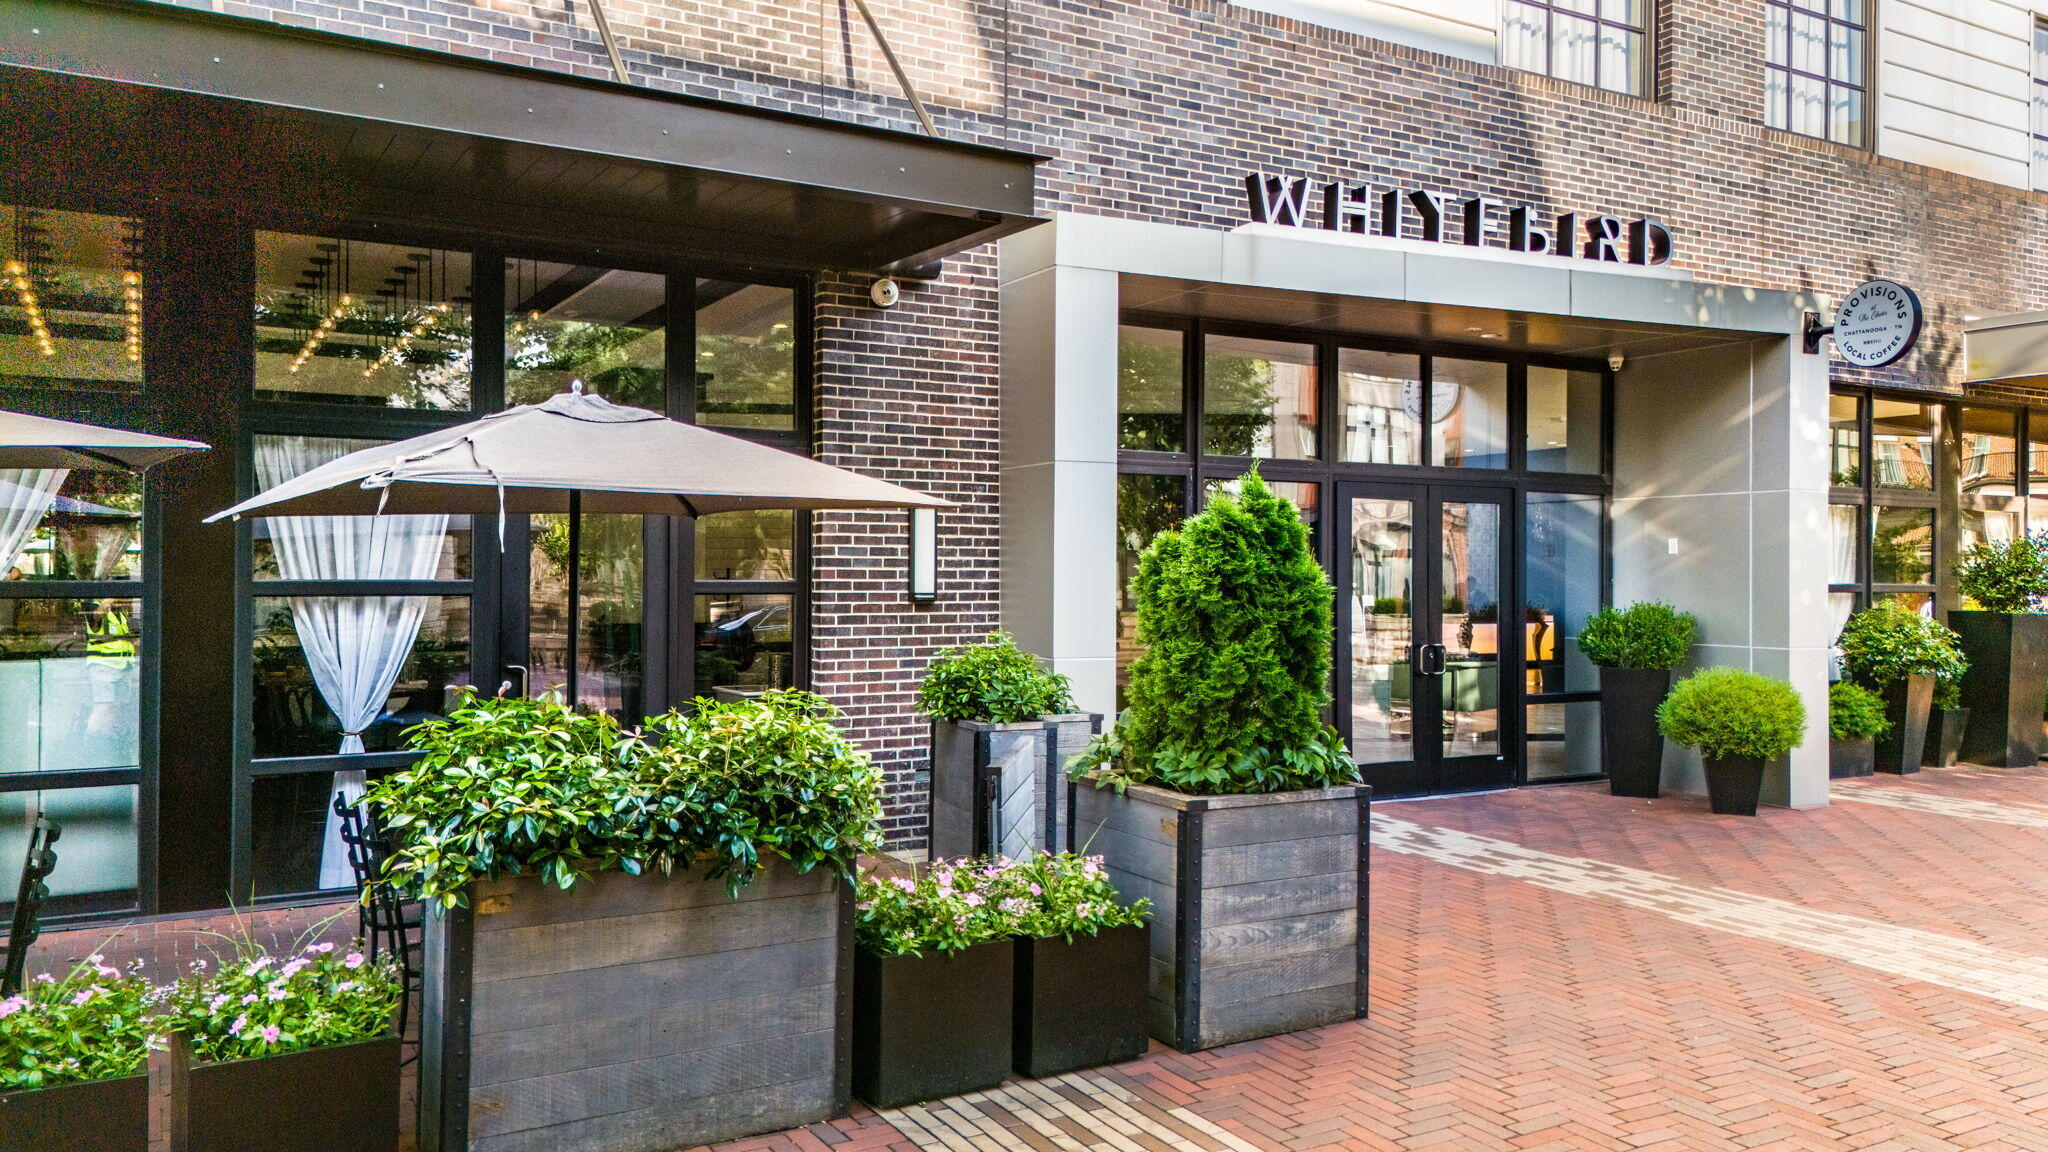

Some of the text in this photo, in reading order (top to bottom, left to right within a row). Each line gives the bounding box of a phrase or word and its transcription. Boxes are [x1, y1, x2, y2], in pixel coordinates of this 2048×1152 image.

[1841, 286, 1906, 326] PROVISIONS
[1844, 326, 1887, 336] CHATTANOOGA
[1843, 335, 1901, 360] LOCAL COFFEE
